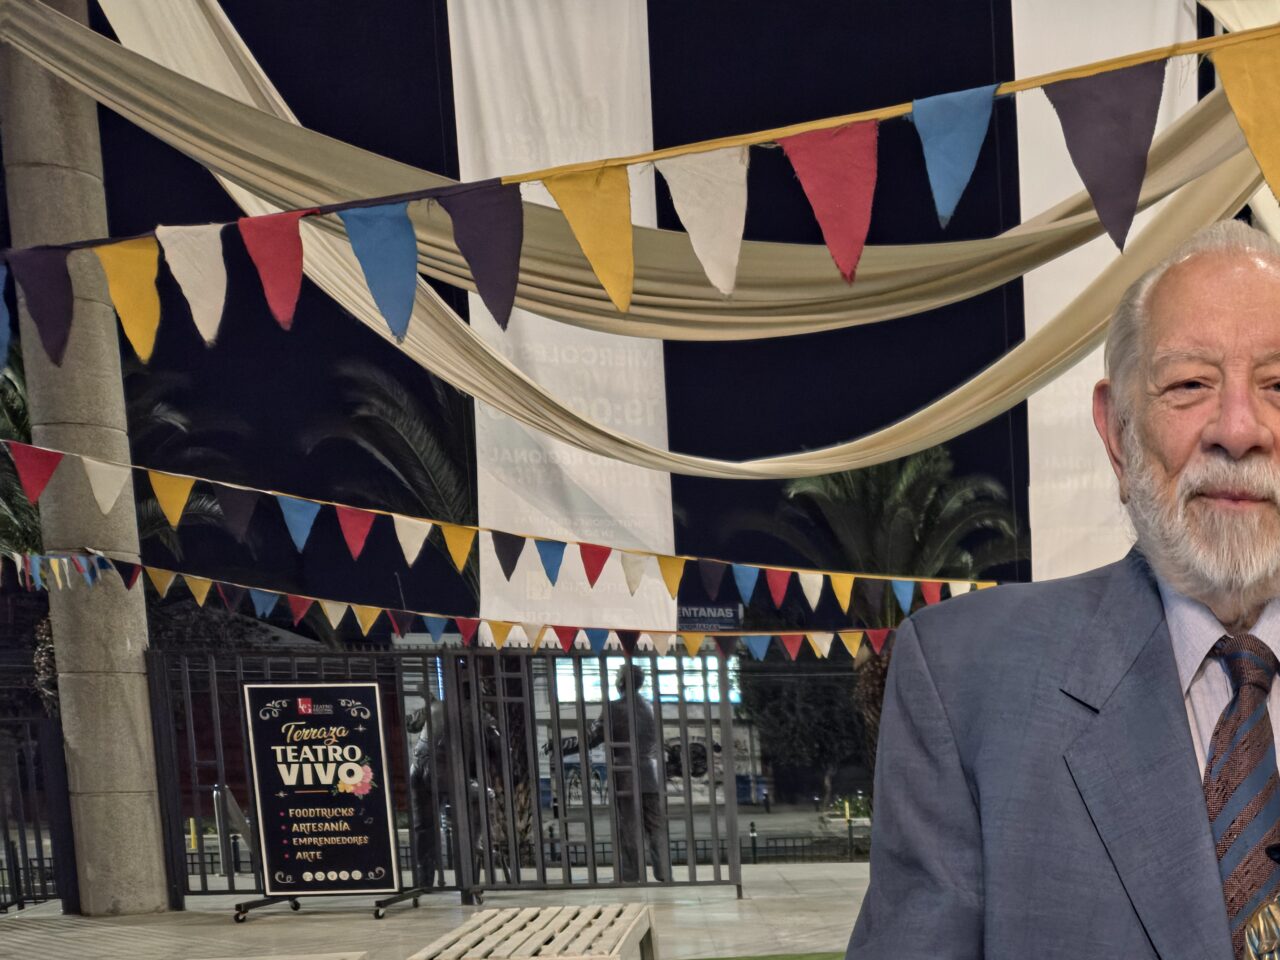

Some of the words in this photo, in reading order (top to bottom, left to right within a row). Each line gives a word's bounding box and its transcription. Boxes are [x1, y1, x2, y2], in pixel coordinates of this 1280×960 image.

[281, 722, 349, 745] Terraza
[271, 745, 362, 762] TEATRO
[276, 762, 364, 786] VIVO
[289, 808, 355, 819] FOODTRUCKS
[292, 820, 350, 834] ARTESANÍA
[292, 836, 369, 847] EMPRENDEDORES
[296, 851, 322, 860] ARTE
